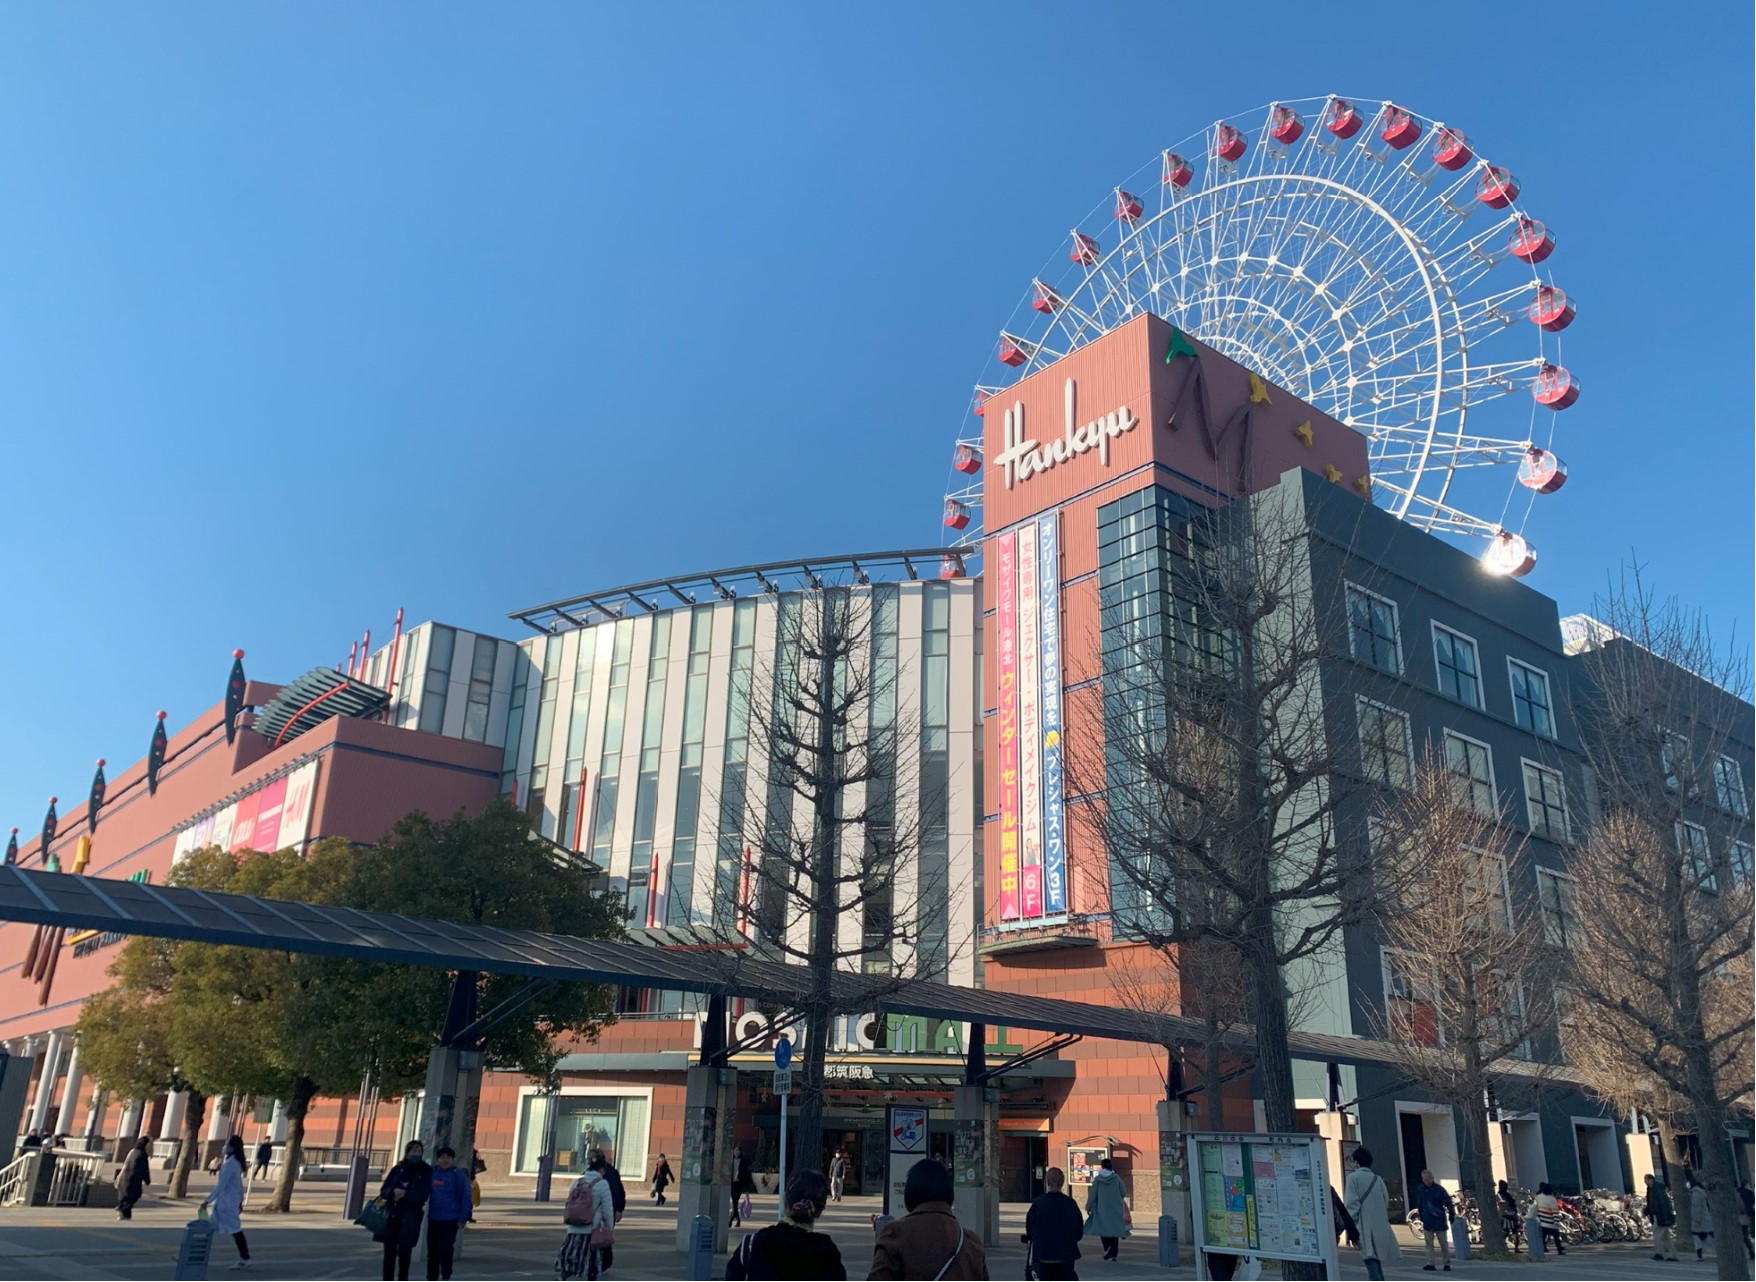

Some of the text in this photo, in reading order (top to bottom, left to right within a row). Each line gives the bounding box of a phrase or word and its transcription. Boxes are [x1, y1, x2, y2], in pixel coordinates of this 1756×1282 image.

[993, 377, 1138, 489] Hankyu
[1000, 671, 1017, 896] ウィンターセール開催中
[823, 1064, 874, 1080] 都筑阪急
